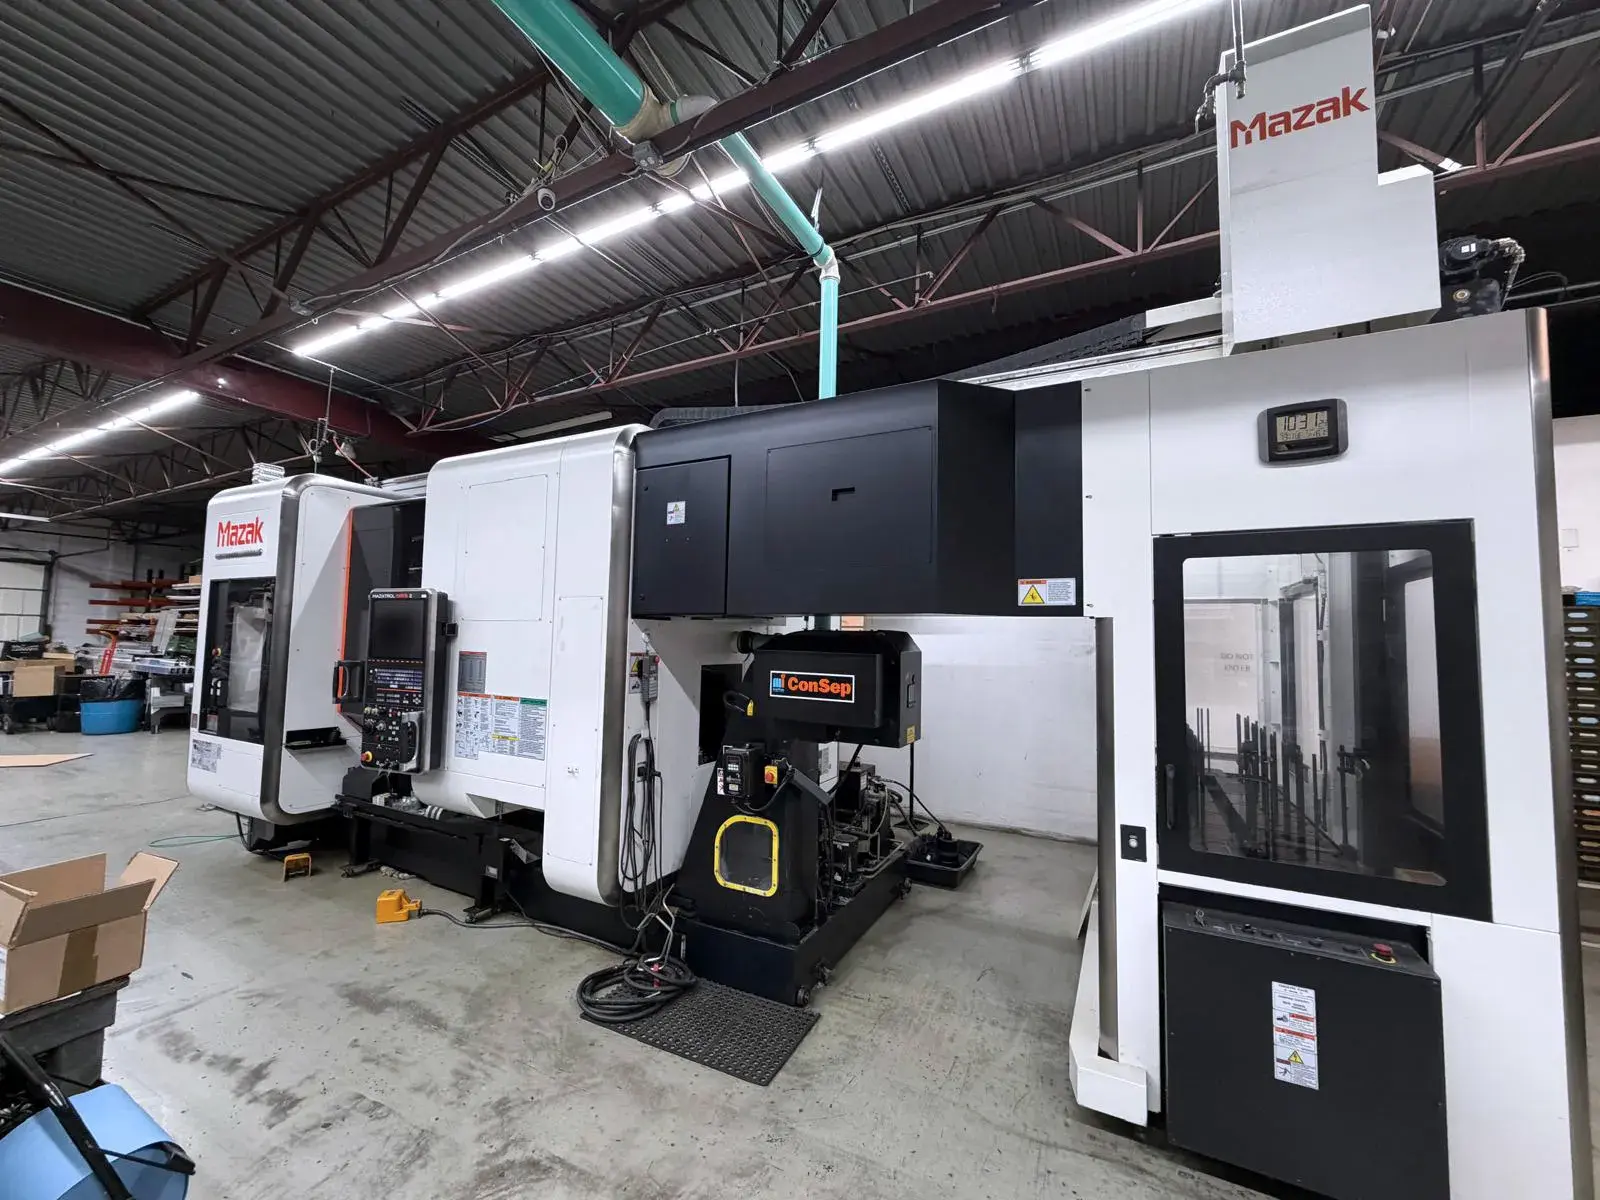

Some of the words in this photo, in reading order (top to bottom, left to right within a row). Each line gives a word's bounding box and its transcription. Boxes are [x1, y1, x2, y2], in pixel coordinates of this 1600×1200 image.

[1230, 86, 1370, 149] Mazak
[217, 516, 264, 547] Mazak
[788, 677, 851, 697] ConSep
